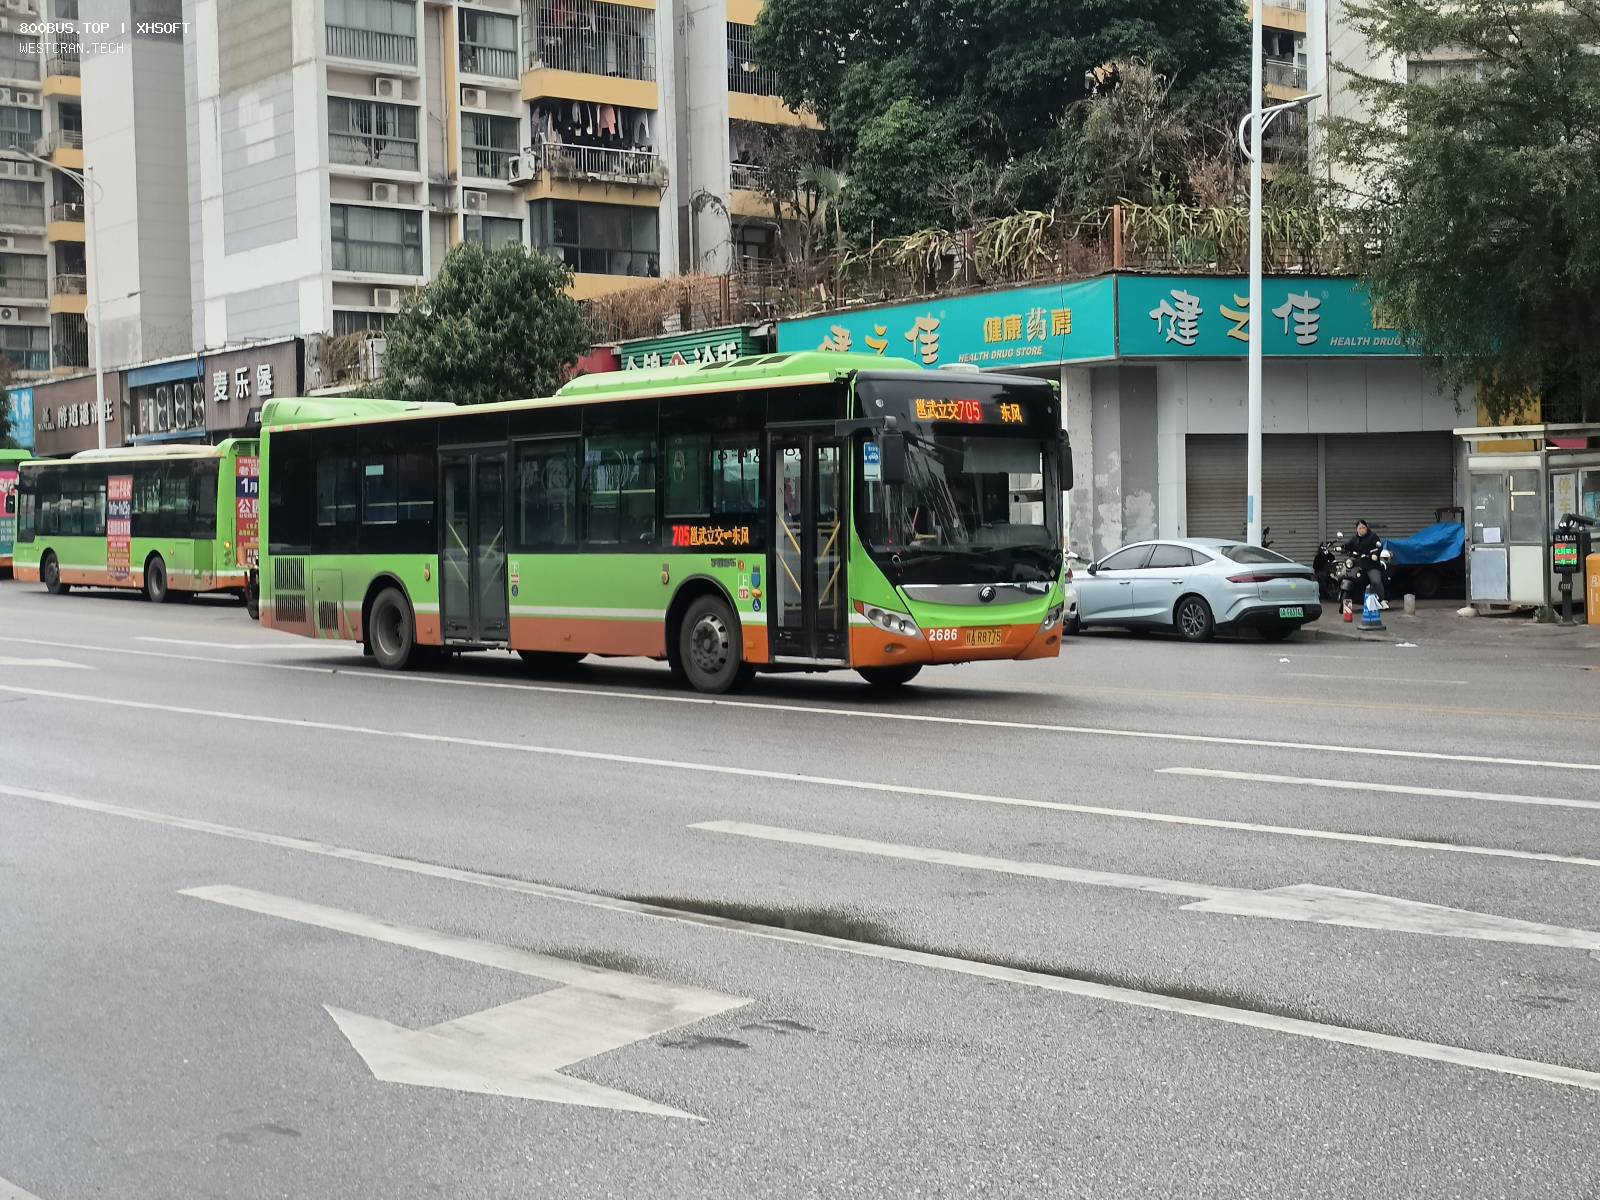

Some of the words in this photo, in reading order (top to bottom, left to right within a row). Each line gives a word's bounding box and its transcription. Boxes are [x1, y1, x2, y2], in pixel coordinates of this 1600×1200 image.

[984, 307, 1073, 343] 健康药房
[1149, 289, 1322, 346] 健之佳
[1330, 337, 1371, 347] HEALTH
[1373, 337, 1401, 347] DRUG
[959, 351, 990, 363] HEALTH
[991, 348, 1014, 360] DRUG
[1016, 346, 1043, 358] STORE
[213, 363, 272, 402] 麦乐堡
[1000, 402, 1023, 422] 东风
[929, 628, 958, 641] 2686
